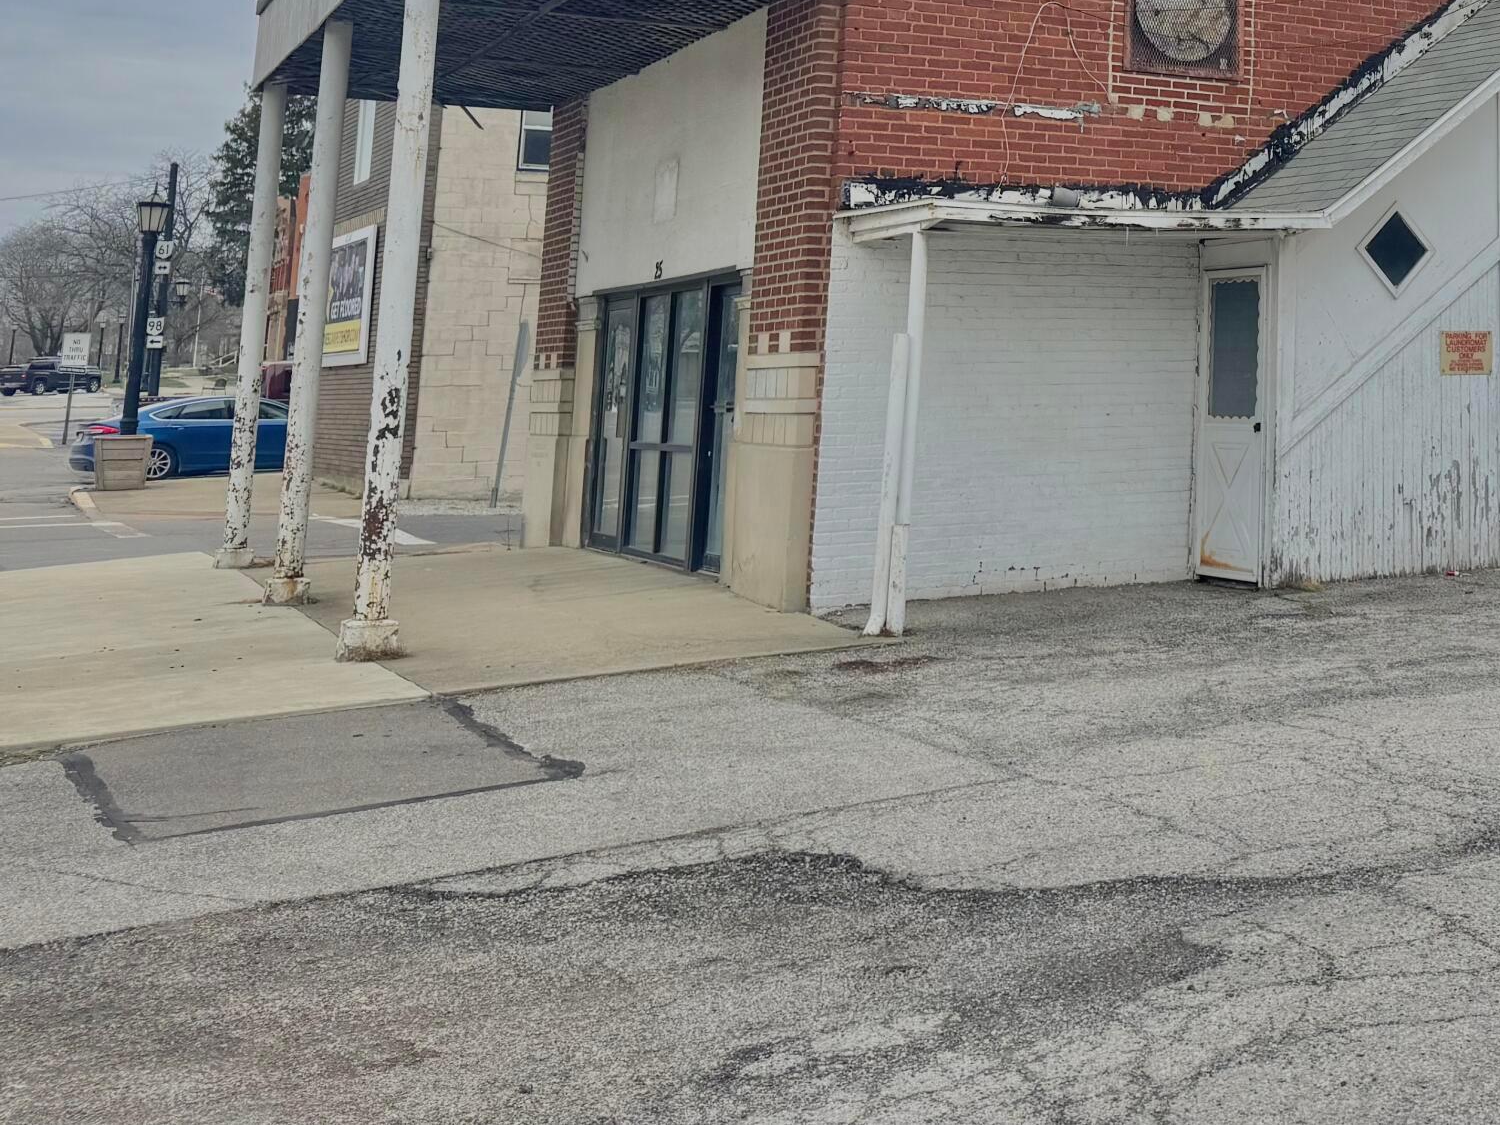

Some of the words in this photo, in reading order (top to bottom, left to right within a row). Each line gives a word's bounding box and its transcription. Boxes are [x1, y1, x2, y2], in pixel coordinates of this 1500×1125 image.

[158, 244, 169, 255] 61
[331, 301, 340, 319] GET
[340, 297, 361, 318] FLOORED
[149, 321, 162, 331] 98
